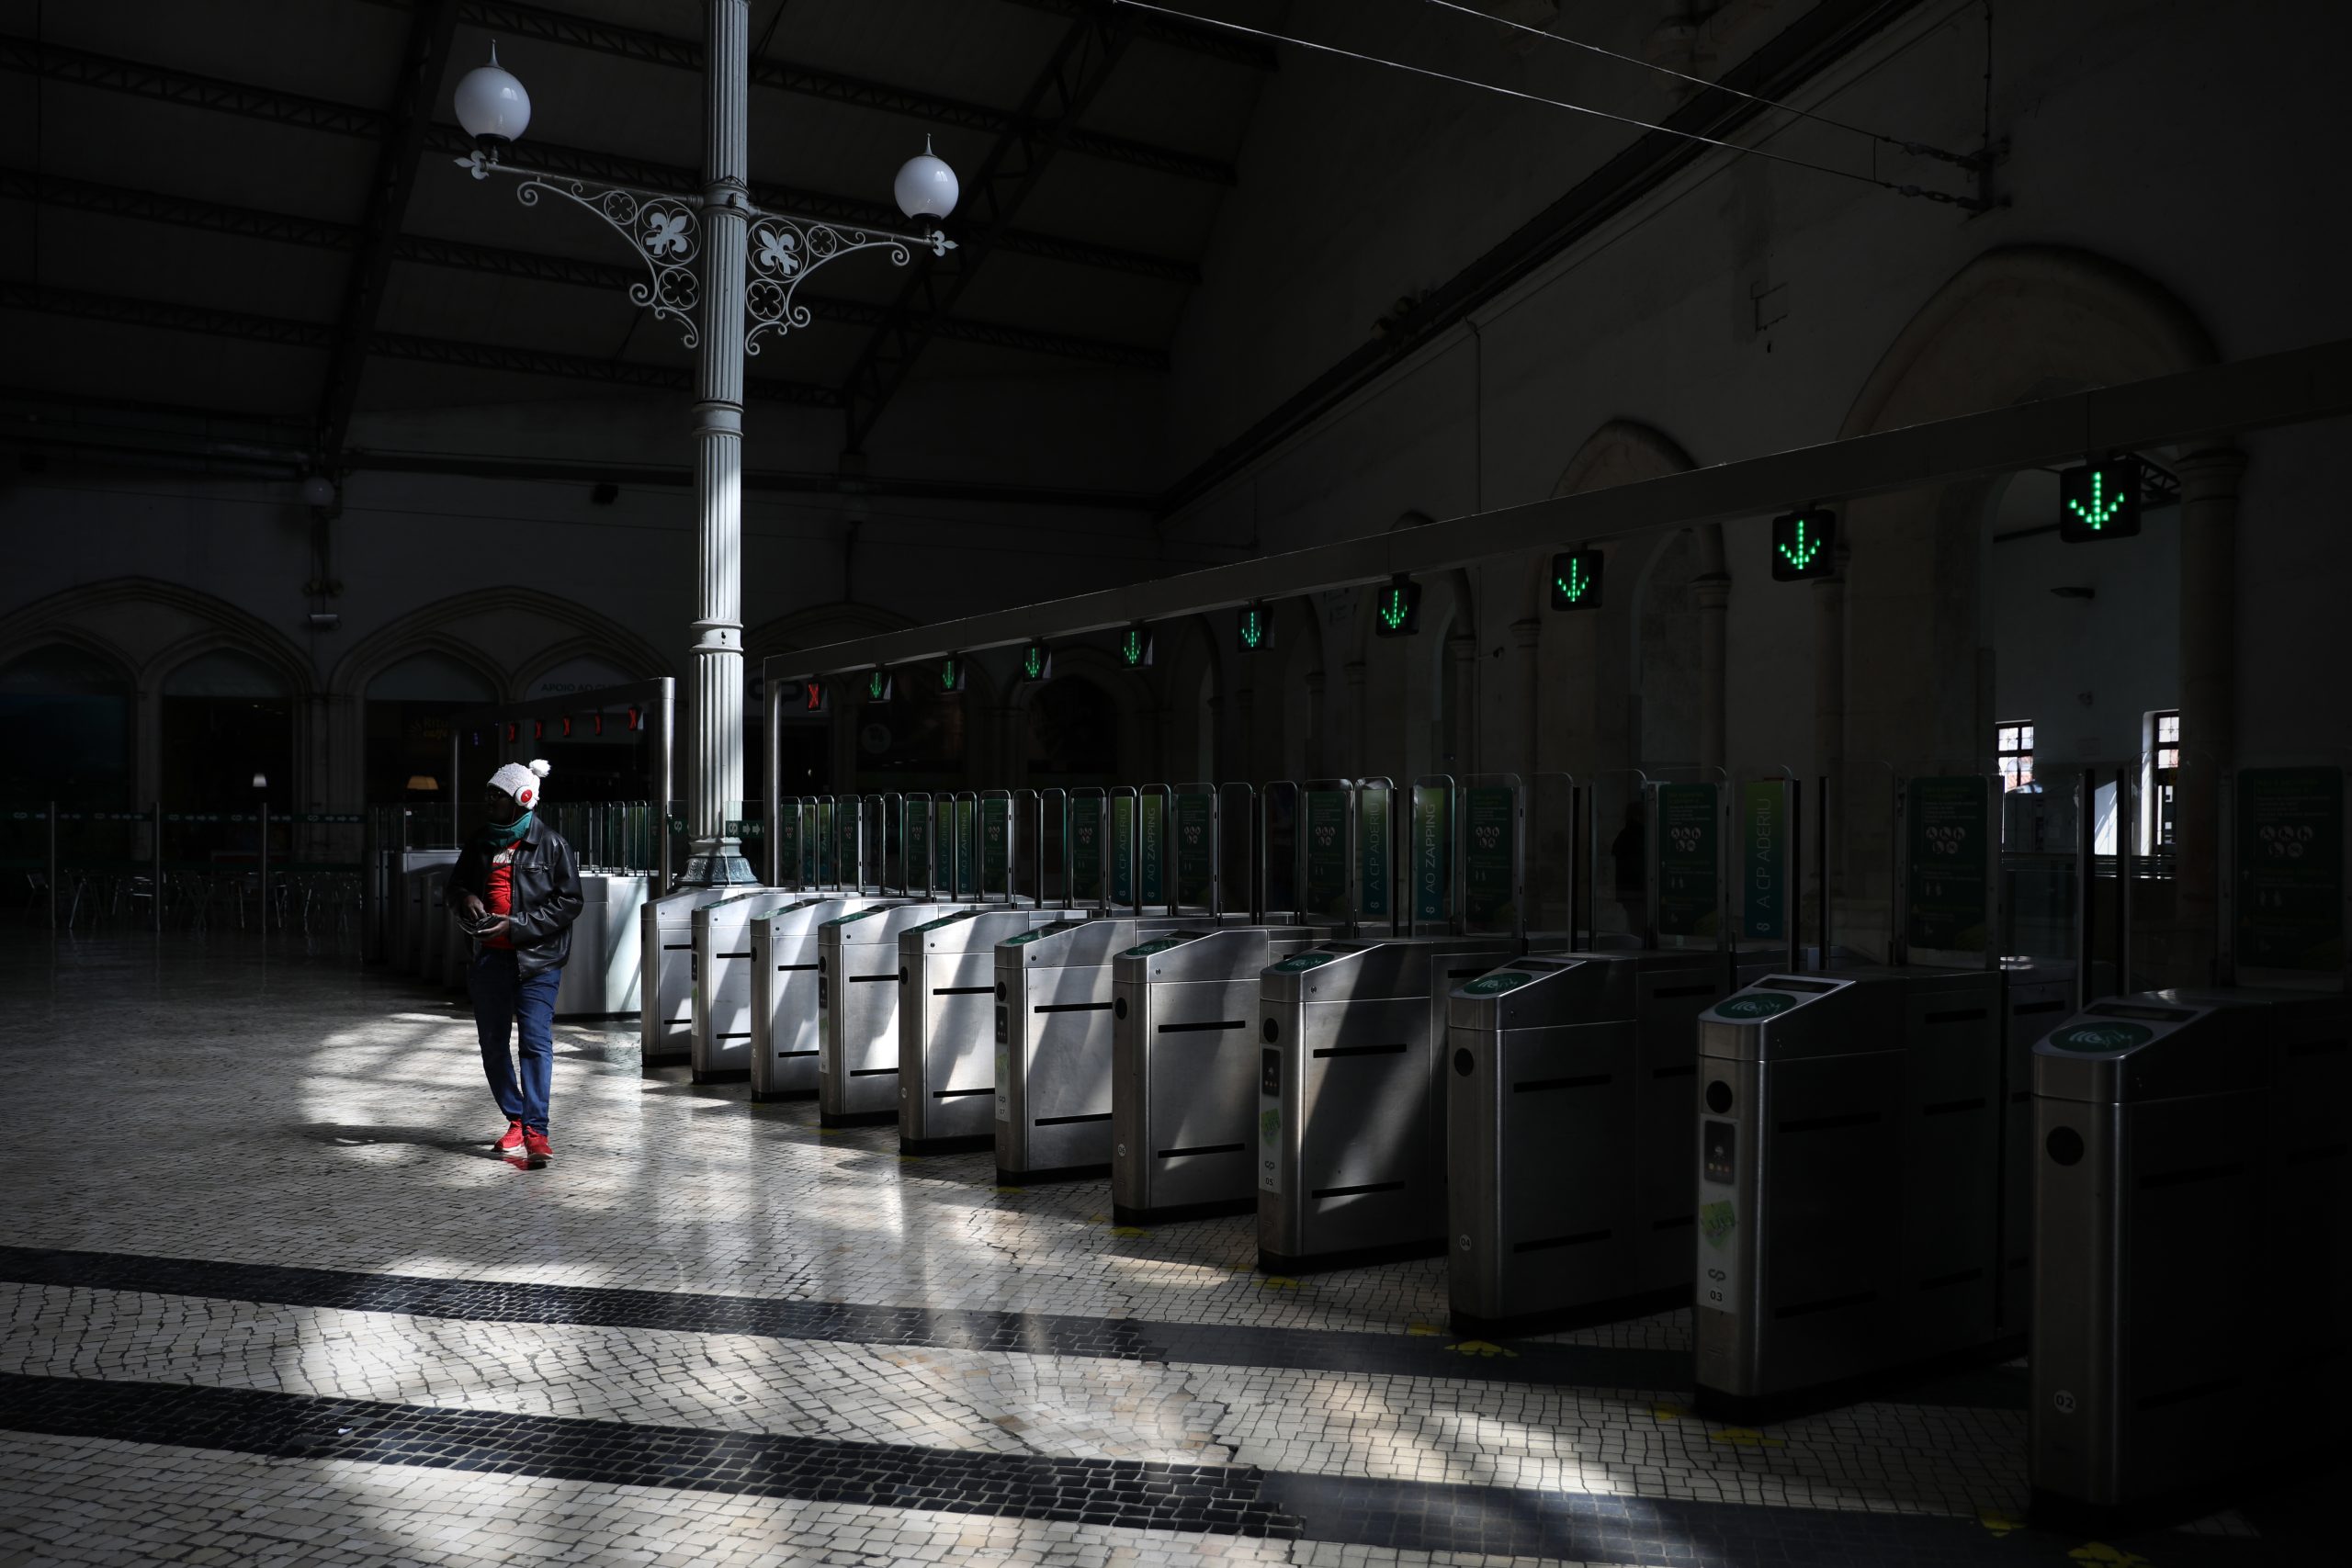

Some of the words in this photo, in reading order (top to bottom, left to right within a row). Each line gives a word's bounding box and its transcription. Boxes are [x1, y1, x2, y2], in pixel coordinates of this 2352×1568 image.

[1147, 807, 1156, 861] ZAPPING
[1369, 802, 1380, 853] ADERIU
[1425, 804, 1435, 868] ZAPPING
[1756, 797, 1771, 863] ADERIU
[1369, 856, 1380, 876] CP
[1425, 872, 1435, 895] AO
[1756, 867, 1771, 891] CP
[1757, 894, 1771, 909] A
[1265, 1177, 1273, 1186] 05
[1461, 1238, 1471, 1247] 04
[1710, 1290, 1723, 1303] 03
[2056, 1394, 2074, 1409] 02
